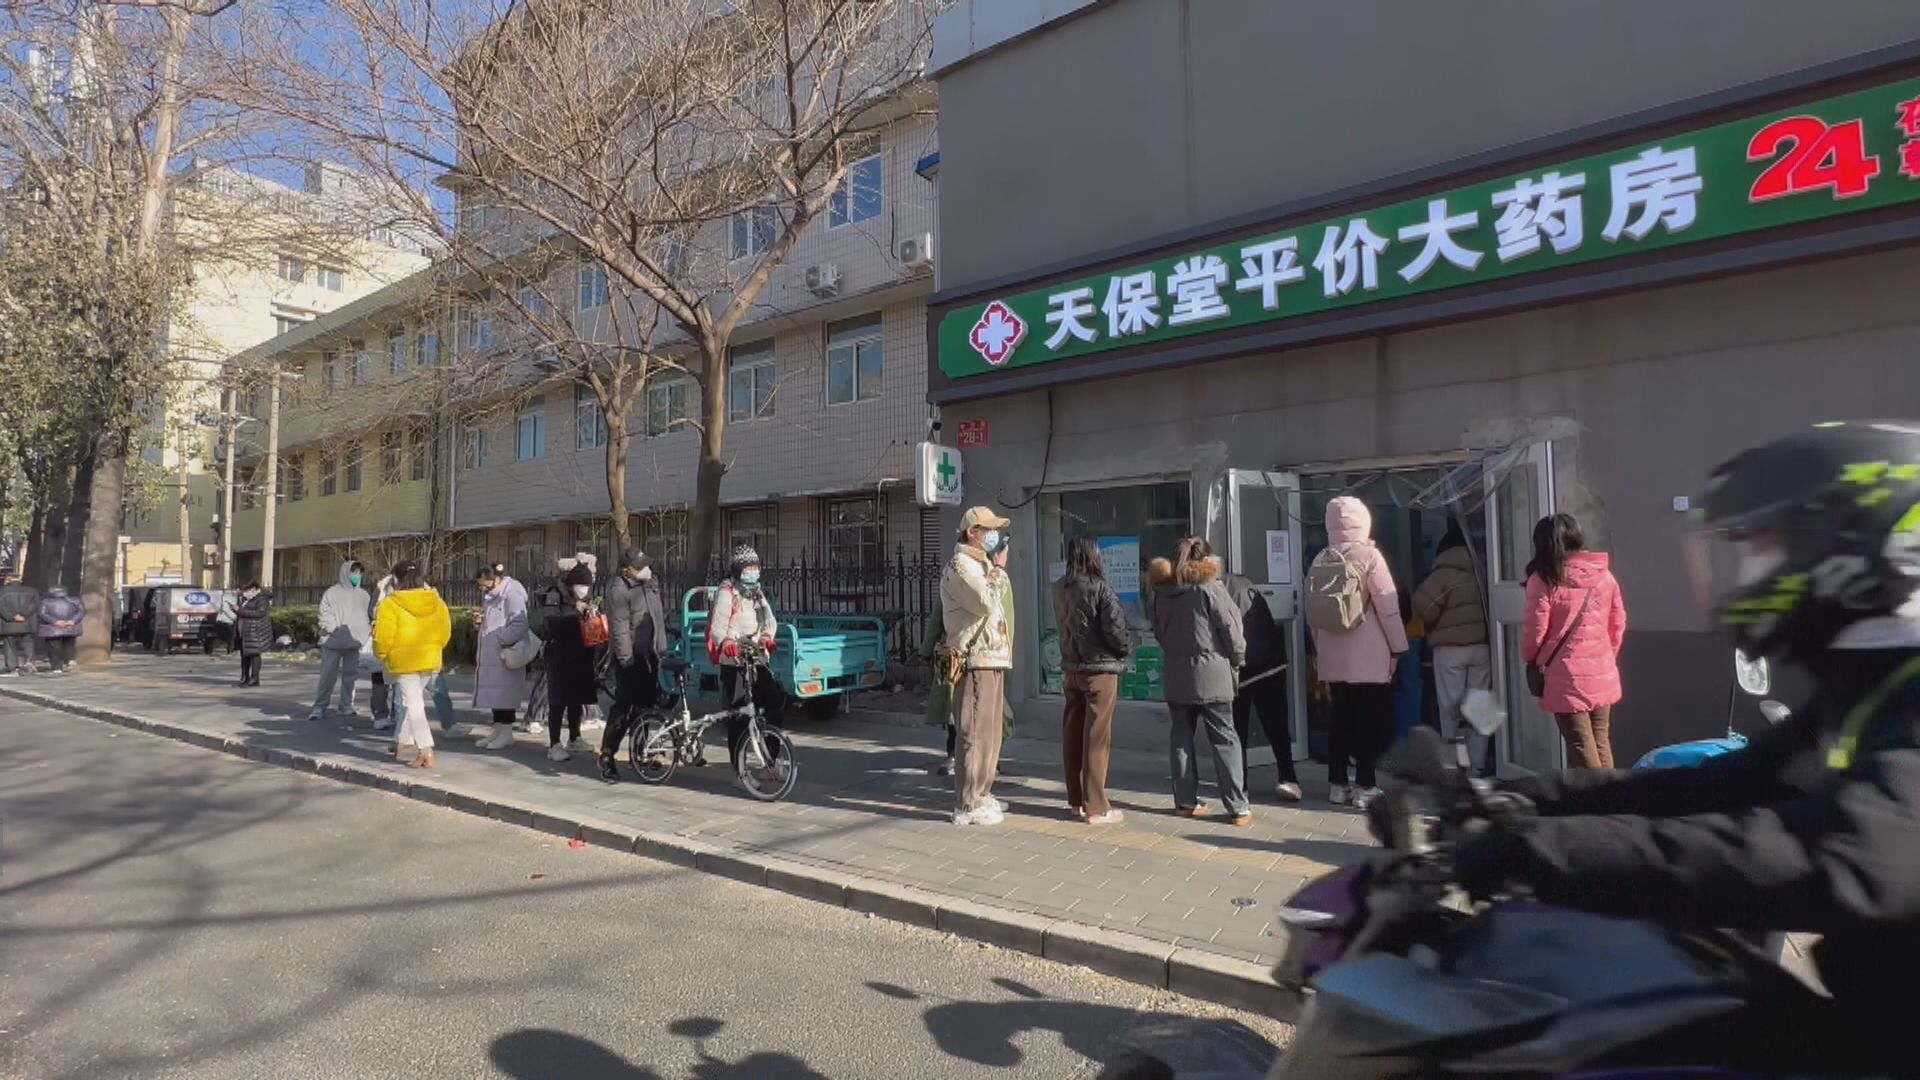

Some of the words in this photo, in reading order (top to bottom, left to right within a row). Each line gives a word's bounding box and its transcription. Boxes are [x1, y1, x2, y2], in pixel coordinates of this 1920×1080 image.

[1746, 114, 1880, 202] 24
[1044, 146, 1703, 351] 天保堂平价大药房
